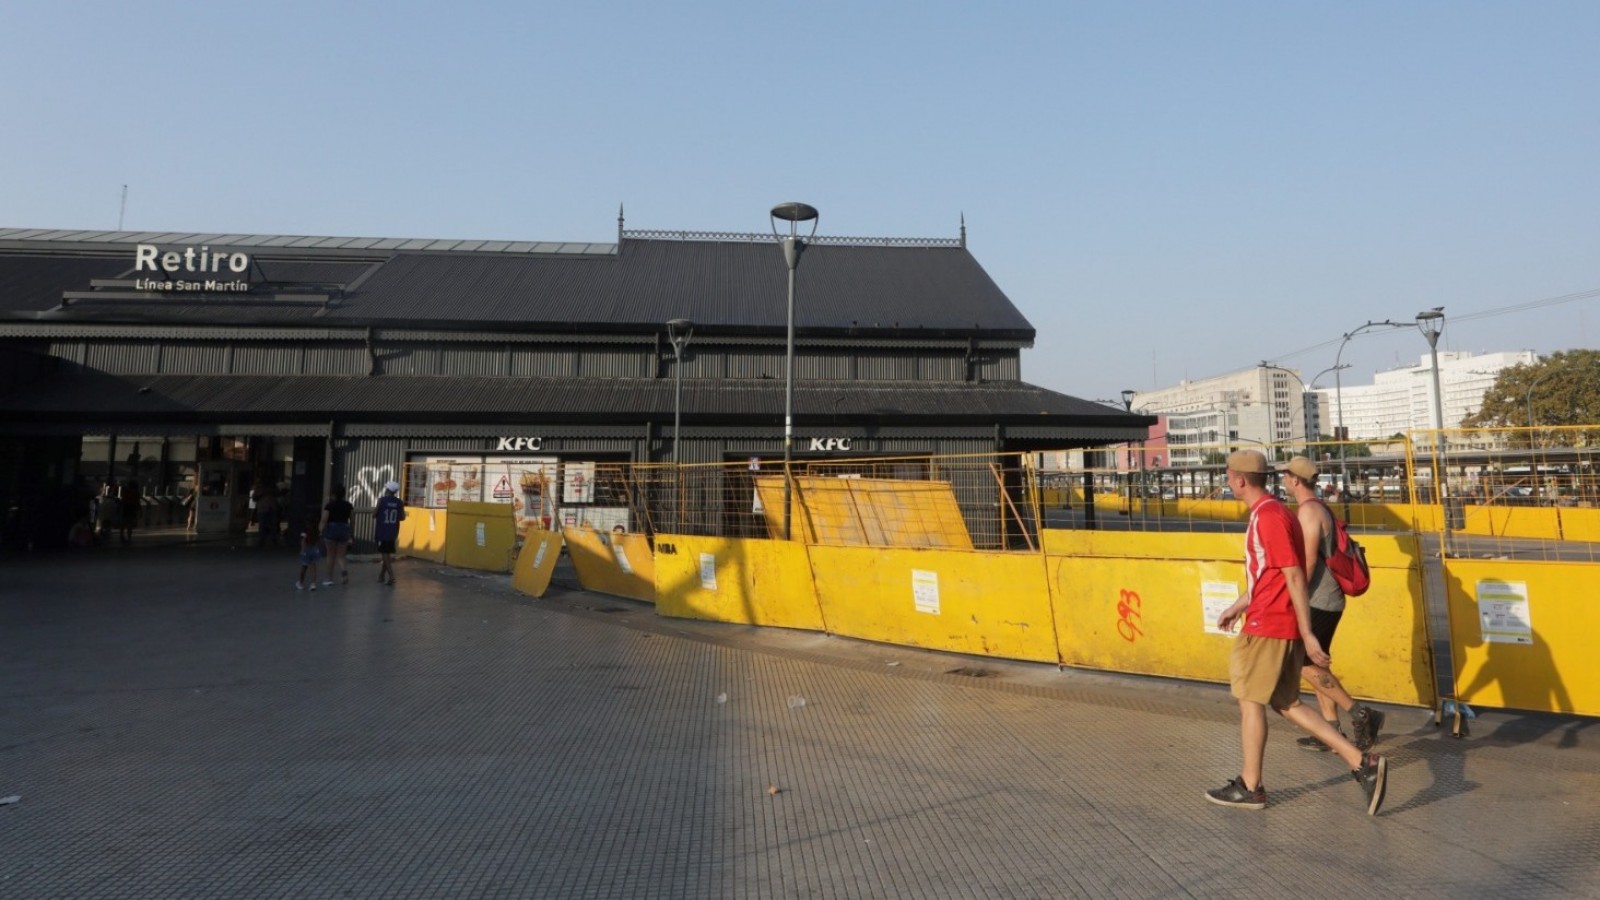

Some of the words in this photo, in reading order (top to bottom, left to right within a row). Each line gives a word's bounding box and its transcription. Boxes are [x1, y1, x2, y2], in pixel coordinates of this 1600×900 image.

[135, 244, 248, 272] Retiro
[135, 278, 172, 290] Línea
[176, 280, 201, 291] San
[204, 278, 248, 291] Martín
[496, 437, 542, 451] KFC
[809, 437, 851, 451] KFC
[384, 509, 398, 524] 10
